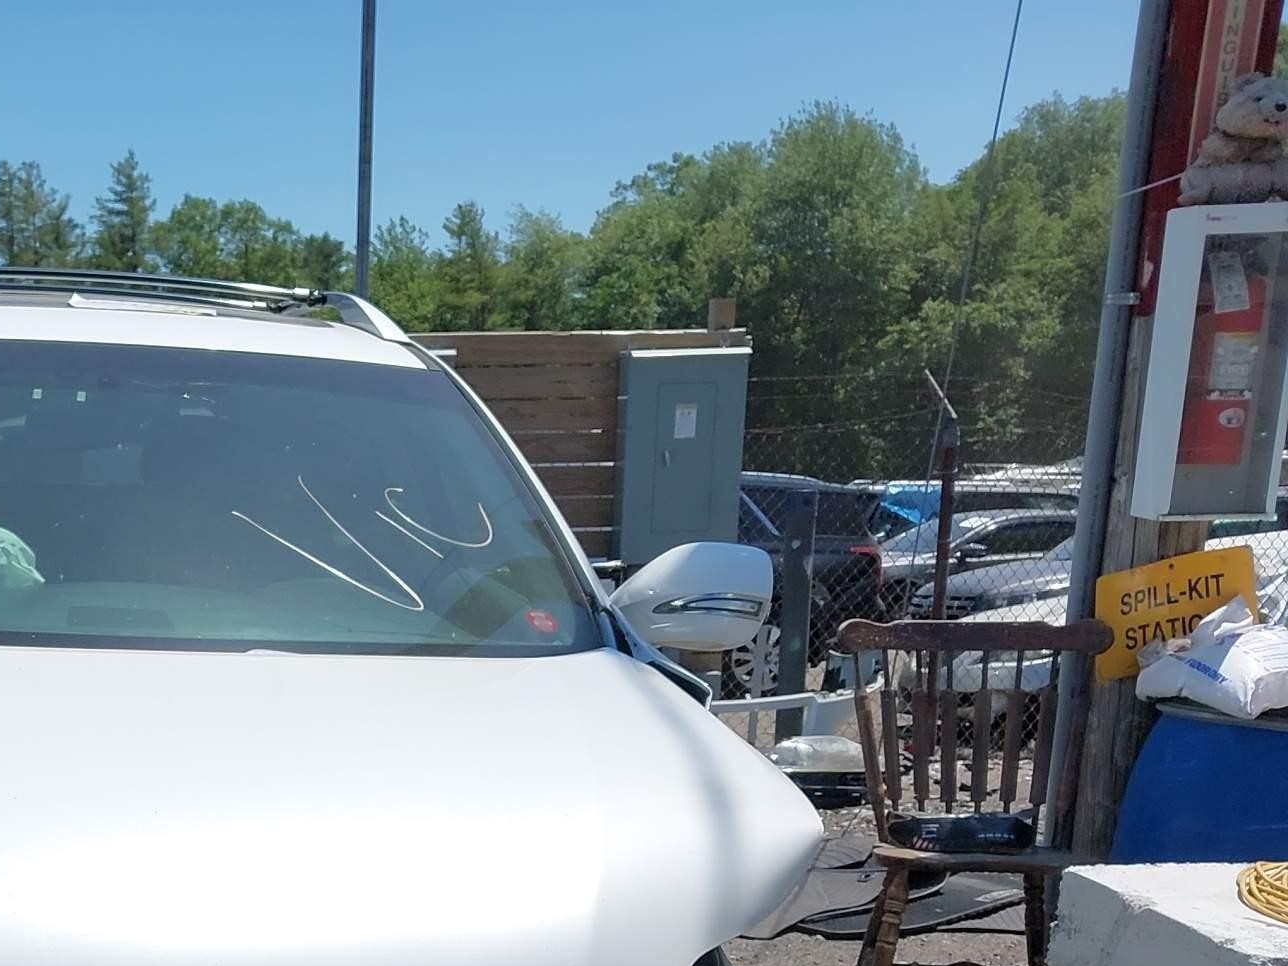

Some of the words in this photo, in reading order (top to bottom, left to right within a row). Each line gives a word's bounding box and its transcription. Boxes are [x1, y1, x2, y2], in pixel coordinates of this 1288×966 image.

[1216, 0, 1239, 111] INGUIS
[1120, 573, 1225, 616] SPILL-KIT
[1125, 611, 1210, 650] STATIO
